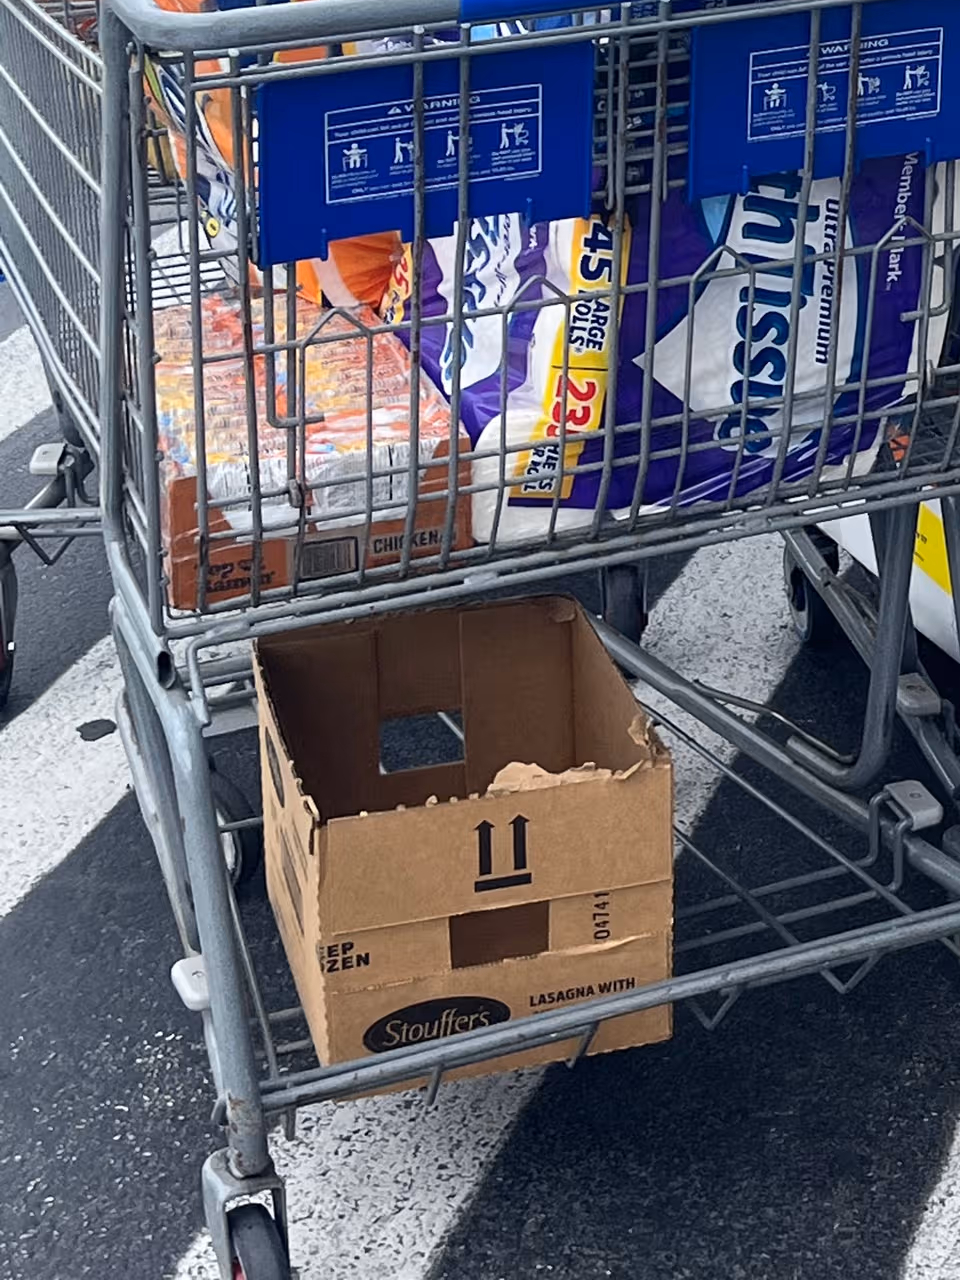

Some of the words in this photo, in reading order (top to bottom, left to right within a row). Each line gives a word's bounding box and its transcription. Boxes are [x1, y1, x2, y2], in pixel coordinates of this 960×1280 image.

[579, 220, 614, 282] 45
[585, 293, 611, 352] ARGE
[529, 984, 596, 1008] LASAGNA
[597, 976, 636, 994] WITH
[381, 1003, 491, 1050] Stouffer's
